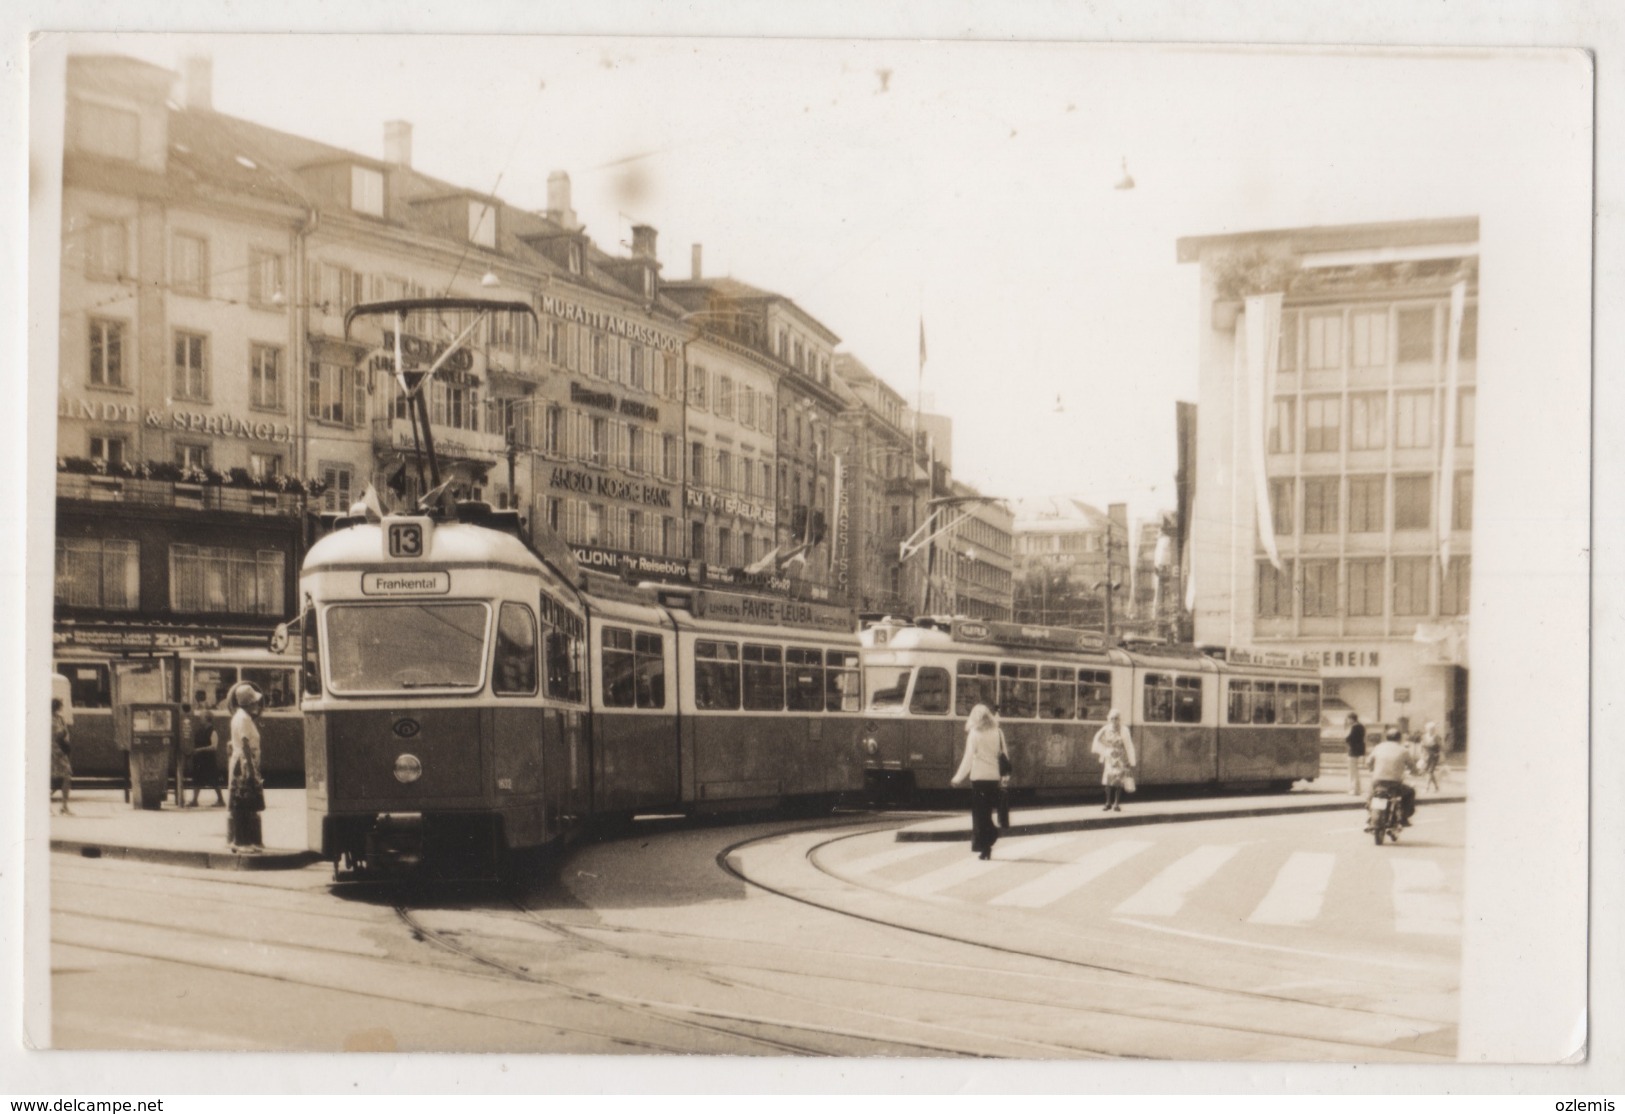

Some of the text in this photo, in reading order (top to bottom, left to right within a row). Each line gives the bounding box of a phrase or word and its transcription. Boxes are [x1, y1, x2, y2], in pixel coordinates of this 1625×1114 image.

[541, 296, 683, 352] MURATTI AMBASSADOR
[145, 407, 163, 426] &
[172, 411, 294, 444] SPRÜNGLI
[550, 467, 671, 508] ANGLO NORDIC BANK
[687, 489, 703, 507] FLY
[393, 528, 420, 554] 13
[573, 548, 617, 567] KUONI
[639, 556, 687, 576] Reisebüro
[376, 577, 436, 590] Frankental
[709, 601, 739, 616] UHREN
[742, 599, 812, 622] FAVRE-LEUBA
[155, 632, 219, 647] Zürich
